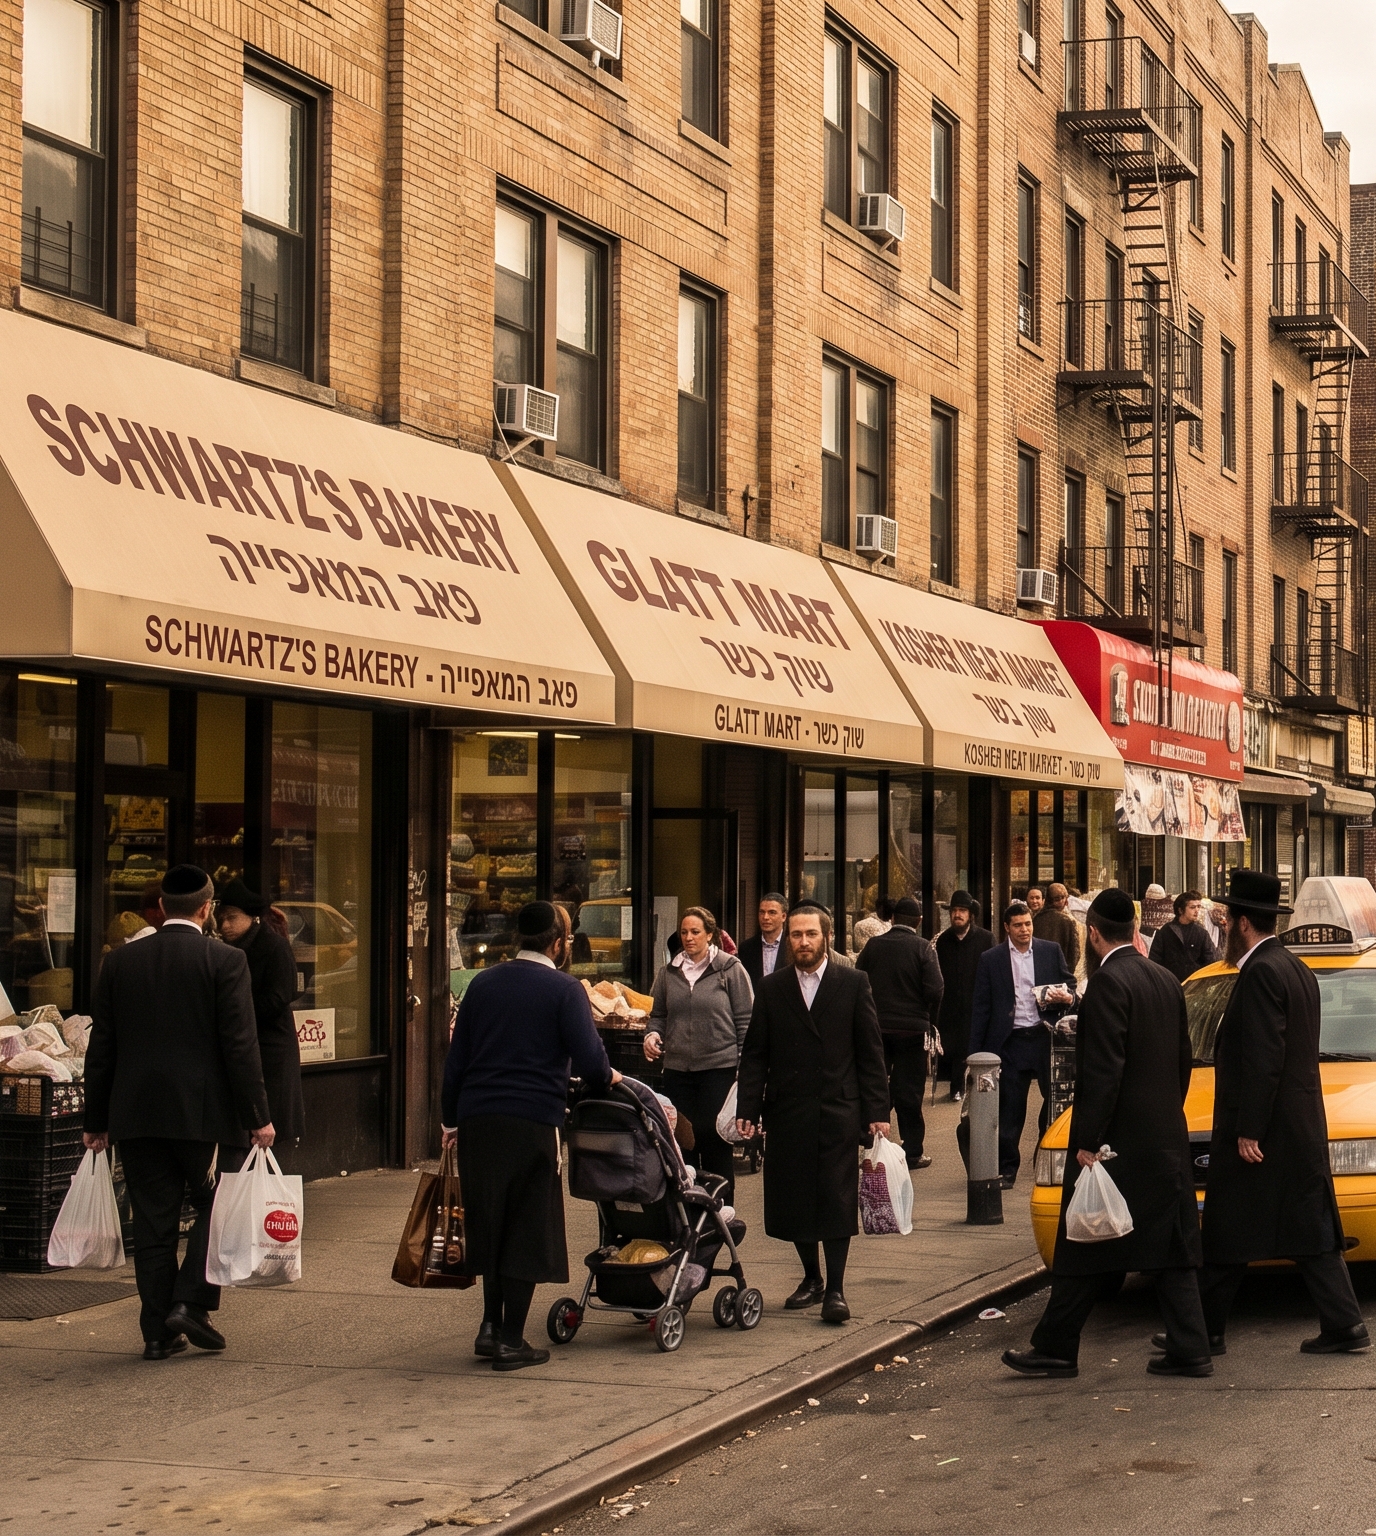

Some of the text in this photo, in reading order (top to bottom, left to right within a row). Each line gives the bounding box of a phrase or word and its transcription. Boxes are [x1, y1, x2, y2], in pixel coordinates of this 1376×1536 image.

[27, 394, 520, 575] SCHWARTZ'S BAKERY
[397, 574, 482, 626] פאב
[586, 540, 852, 651] GLATT MART
[145, 615, 317, 676] SCHWARTZ'S
[325, 643, 419, 689] BAKERY
[538, 677, 578, 708] פאב
[699, 636, 834, 697] שוק כשר
[878, 618, 969, 676] KOSHER
[715, 704, 760, 735] GLATT
[764, 711, 802, 741] MART
[843, 725, 864, 754] שוק
